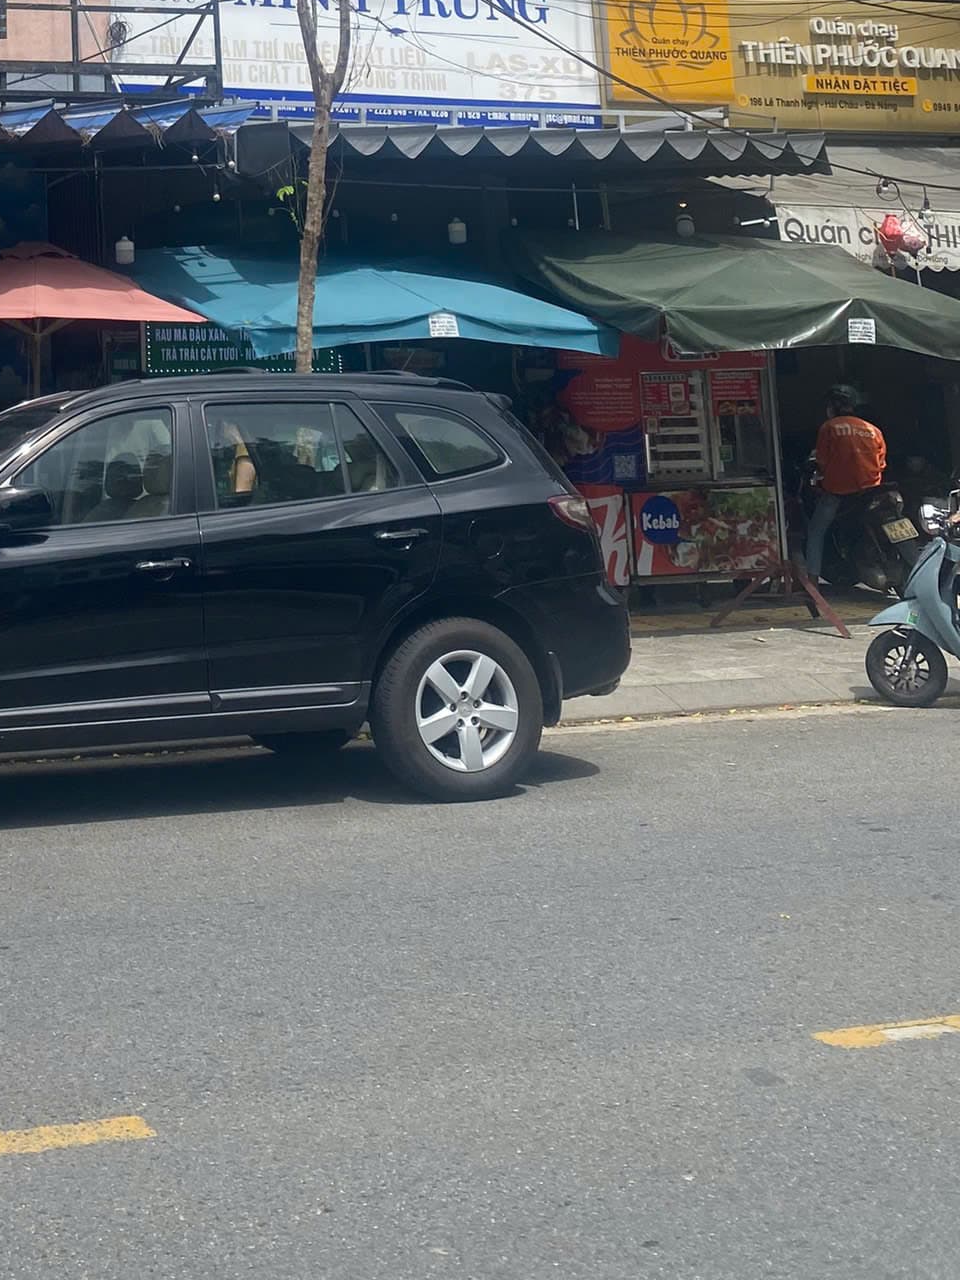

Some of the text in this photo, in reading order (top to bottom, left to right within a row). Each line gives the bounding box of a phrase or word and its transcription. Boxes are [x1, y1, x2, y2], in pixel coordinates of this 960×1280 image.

[810, 16, 899, 41] Quán chay
[689, 49, 728, 61] QUANG
[741, 36, 813, 66] THIÊN
[814, 38, 898, 68] PHƯỚC
[815, 77, 909, 95] NHẬN ĐẶT TIỆC
[784, 218, 852, 245] Quán
[923, 223, 960, 249] THI
[642, 512, 680, 531] Kebab
